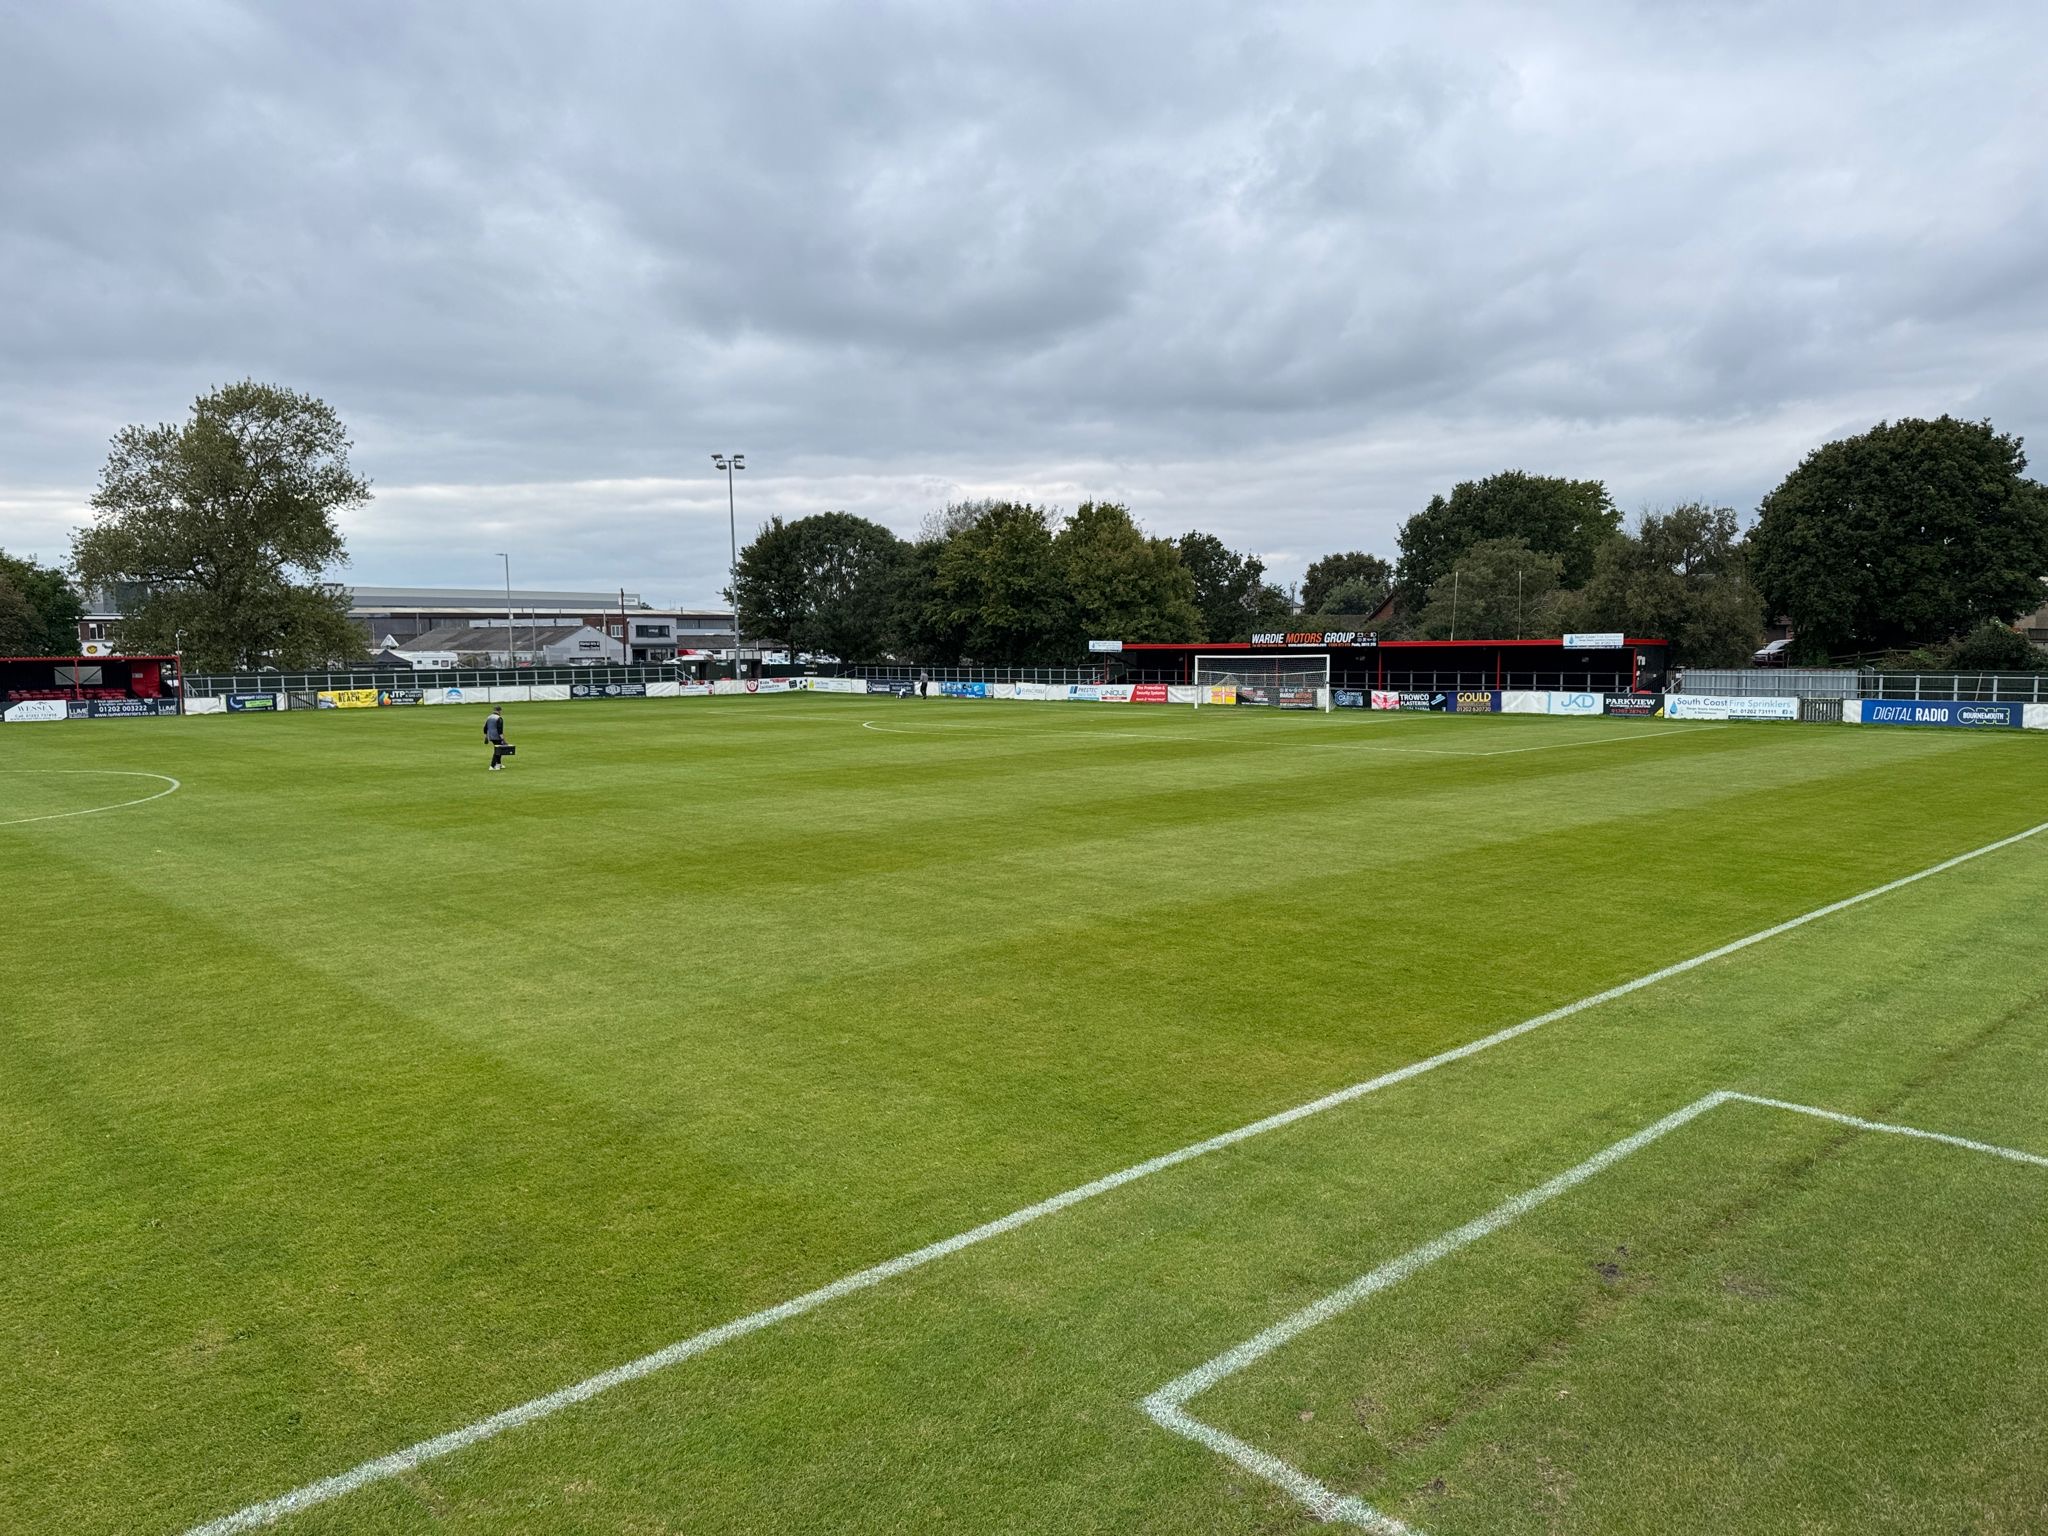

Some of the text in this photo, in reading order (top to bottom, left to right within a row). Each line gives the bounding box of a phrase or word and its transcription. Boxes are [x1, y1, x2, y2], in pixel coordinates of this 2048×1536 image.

[1251, 632, 1356, 644] WARDIE MOTORS GROUP
[390, 690, 406, 698] JTP
[1400, 693, 1430, 701] TROWCO
[1457, 692, 1492, 702] GOULD
[1561, 694, 1595, 708] JKD
[1677, 697, 1791, 708] South Coast Fire Sprinklers
[1873, 706, 1949, 722] DIGITAL RADIO
[1962, 711, 2004, 720] BOURNEMOUTH
